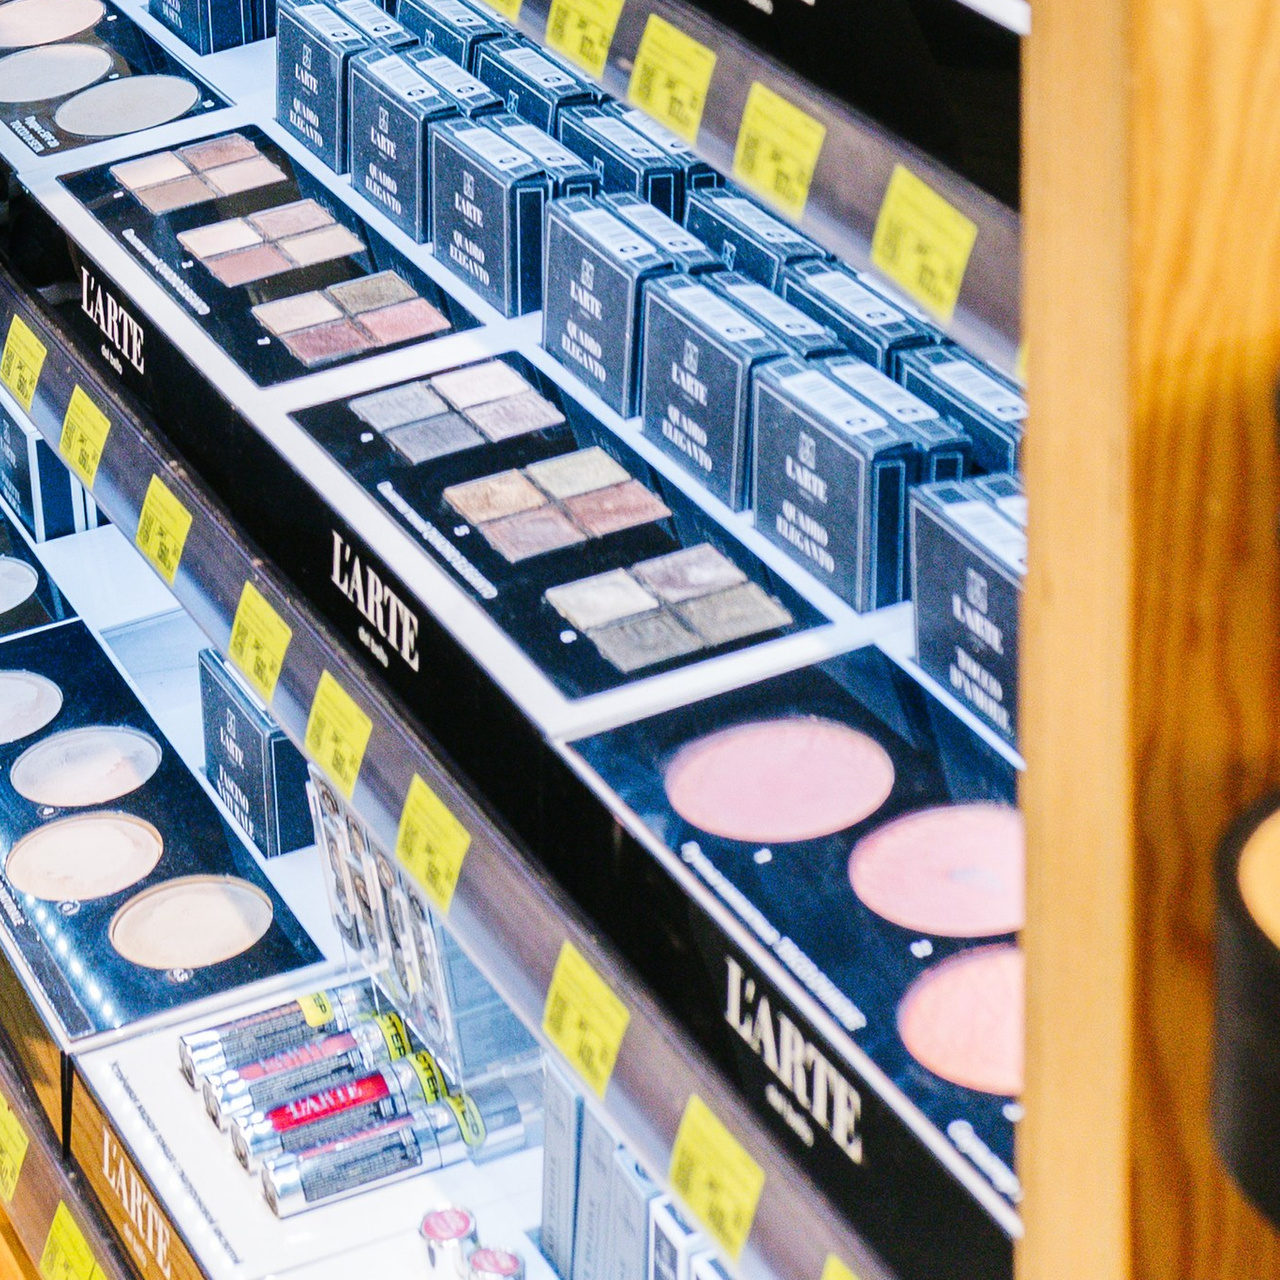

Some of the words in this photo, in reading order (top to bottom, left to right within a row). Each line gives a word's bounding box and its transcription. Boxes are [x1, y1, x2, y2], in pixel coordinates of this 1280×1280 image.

[295, 63, 319, 95] L'ARTE
[289, 109, 323, 149] ELEGANTO
[293, 97, 319, 128] QUADRO
[370, 127, 397, 160] L'ARTE
[366, 176, 402, 216] ELEGANTO
[369, 162, 398, 195] QUADRO
[454, 192, 484, 228] L'ARTE
[449, 243, 490, 287] ELEGANTO
[453, 229, 485, 265] QUADRO
[81, 265, 145, 375] L'ARTE
[330, 529, 420, 672] L'ARTE
[724, 955, 862, 1165] L'ARTE
[103, 1125, 170, 1279] L'ARTE
